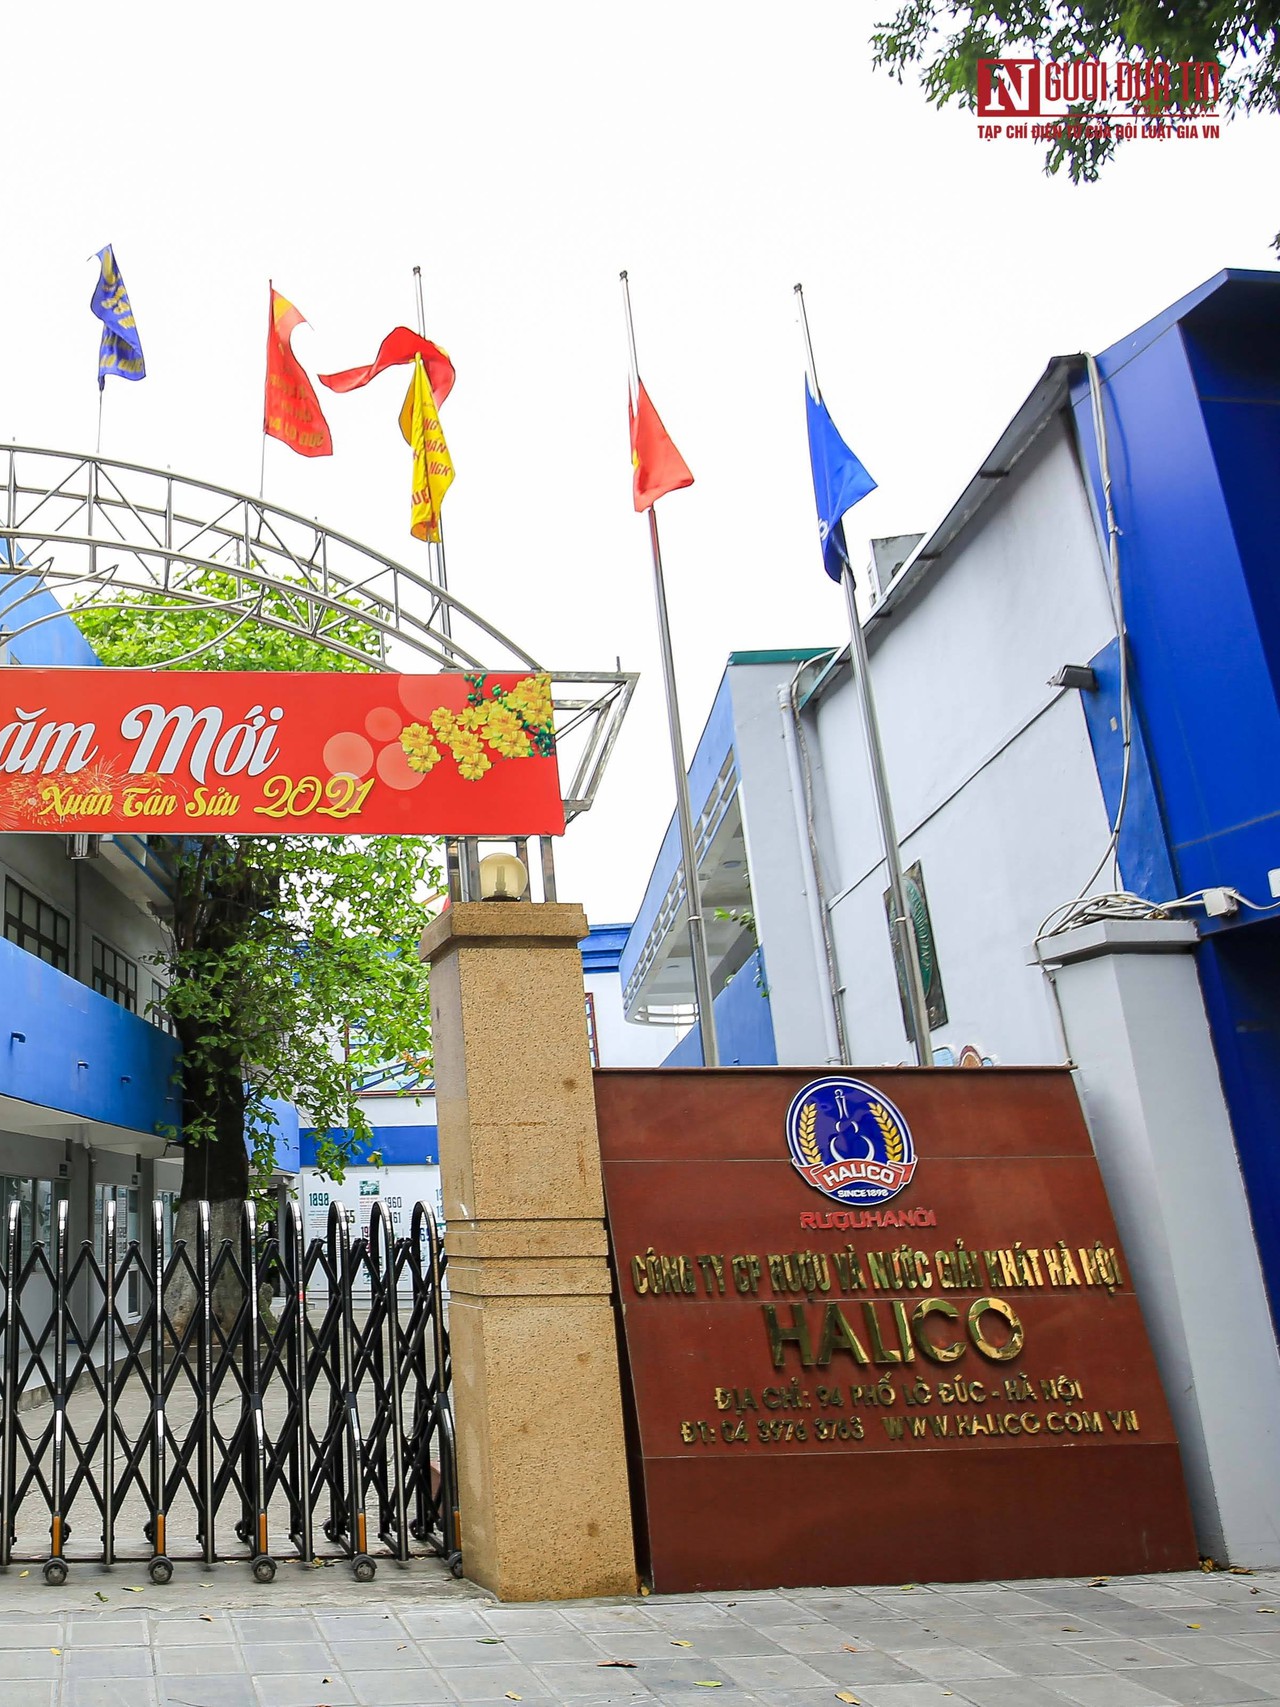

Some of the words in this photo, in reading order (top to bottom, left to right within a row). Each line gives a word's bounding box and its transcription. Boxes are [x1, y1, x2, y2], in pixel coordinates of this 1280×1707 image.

[120, 703, 285, 785] Mới
[39, 785, 114, 816] Xuân
[123, 786, 178, 817] Tân
[185, 786, 242, 817] Sửu
[253, 775, 376, 819] 2021
[823, 1163, 895, 1187] HALICO
[837, 1189, 867, 1198] SINCE
[867, 1188, 889, 1198] 1898
[309, 1192, 329, 1207] 1898
[631, 1247, 696, 1294] CÔNG
[697, 1255, 725, 1292] TY
[732, 1254, 761, 1293] CP
[767, 1249, 831, 1302] RƯỢU
[832, 1244, 867, 1291] VÀ
[867, 1244, 932, 1289] NƯỚC
[935, 1238, 983, 1288] GIẢI
[982, 1241, 1044, 1287] KHÁT
[1043, 1240, 1082, 1286] HÀ
[1078, 1240, 1124, 1295] NỘI
[762, 1297, 1024, 1366] HALICO
[714, 1387, 758, 1415] ĐỊA
[762, 1377, 812, 1409] CHỈ:
[816, 1386, 844, 1408] 94
[850, 1372, 896, 1407] PHỐ
[902, 1376, 931, 1406] LÒ
[1003, 1372, 1038, 1403] HÀ
[1040, 1374, 1084, 1407] NỘI
[681, 1420, 716, 1443] ĐT:
[722, 1419, 749, 1443] 04
[757, 1418, 809, 1443] 3976
